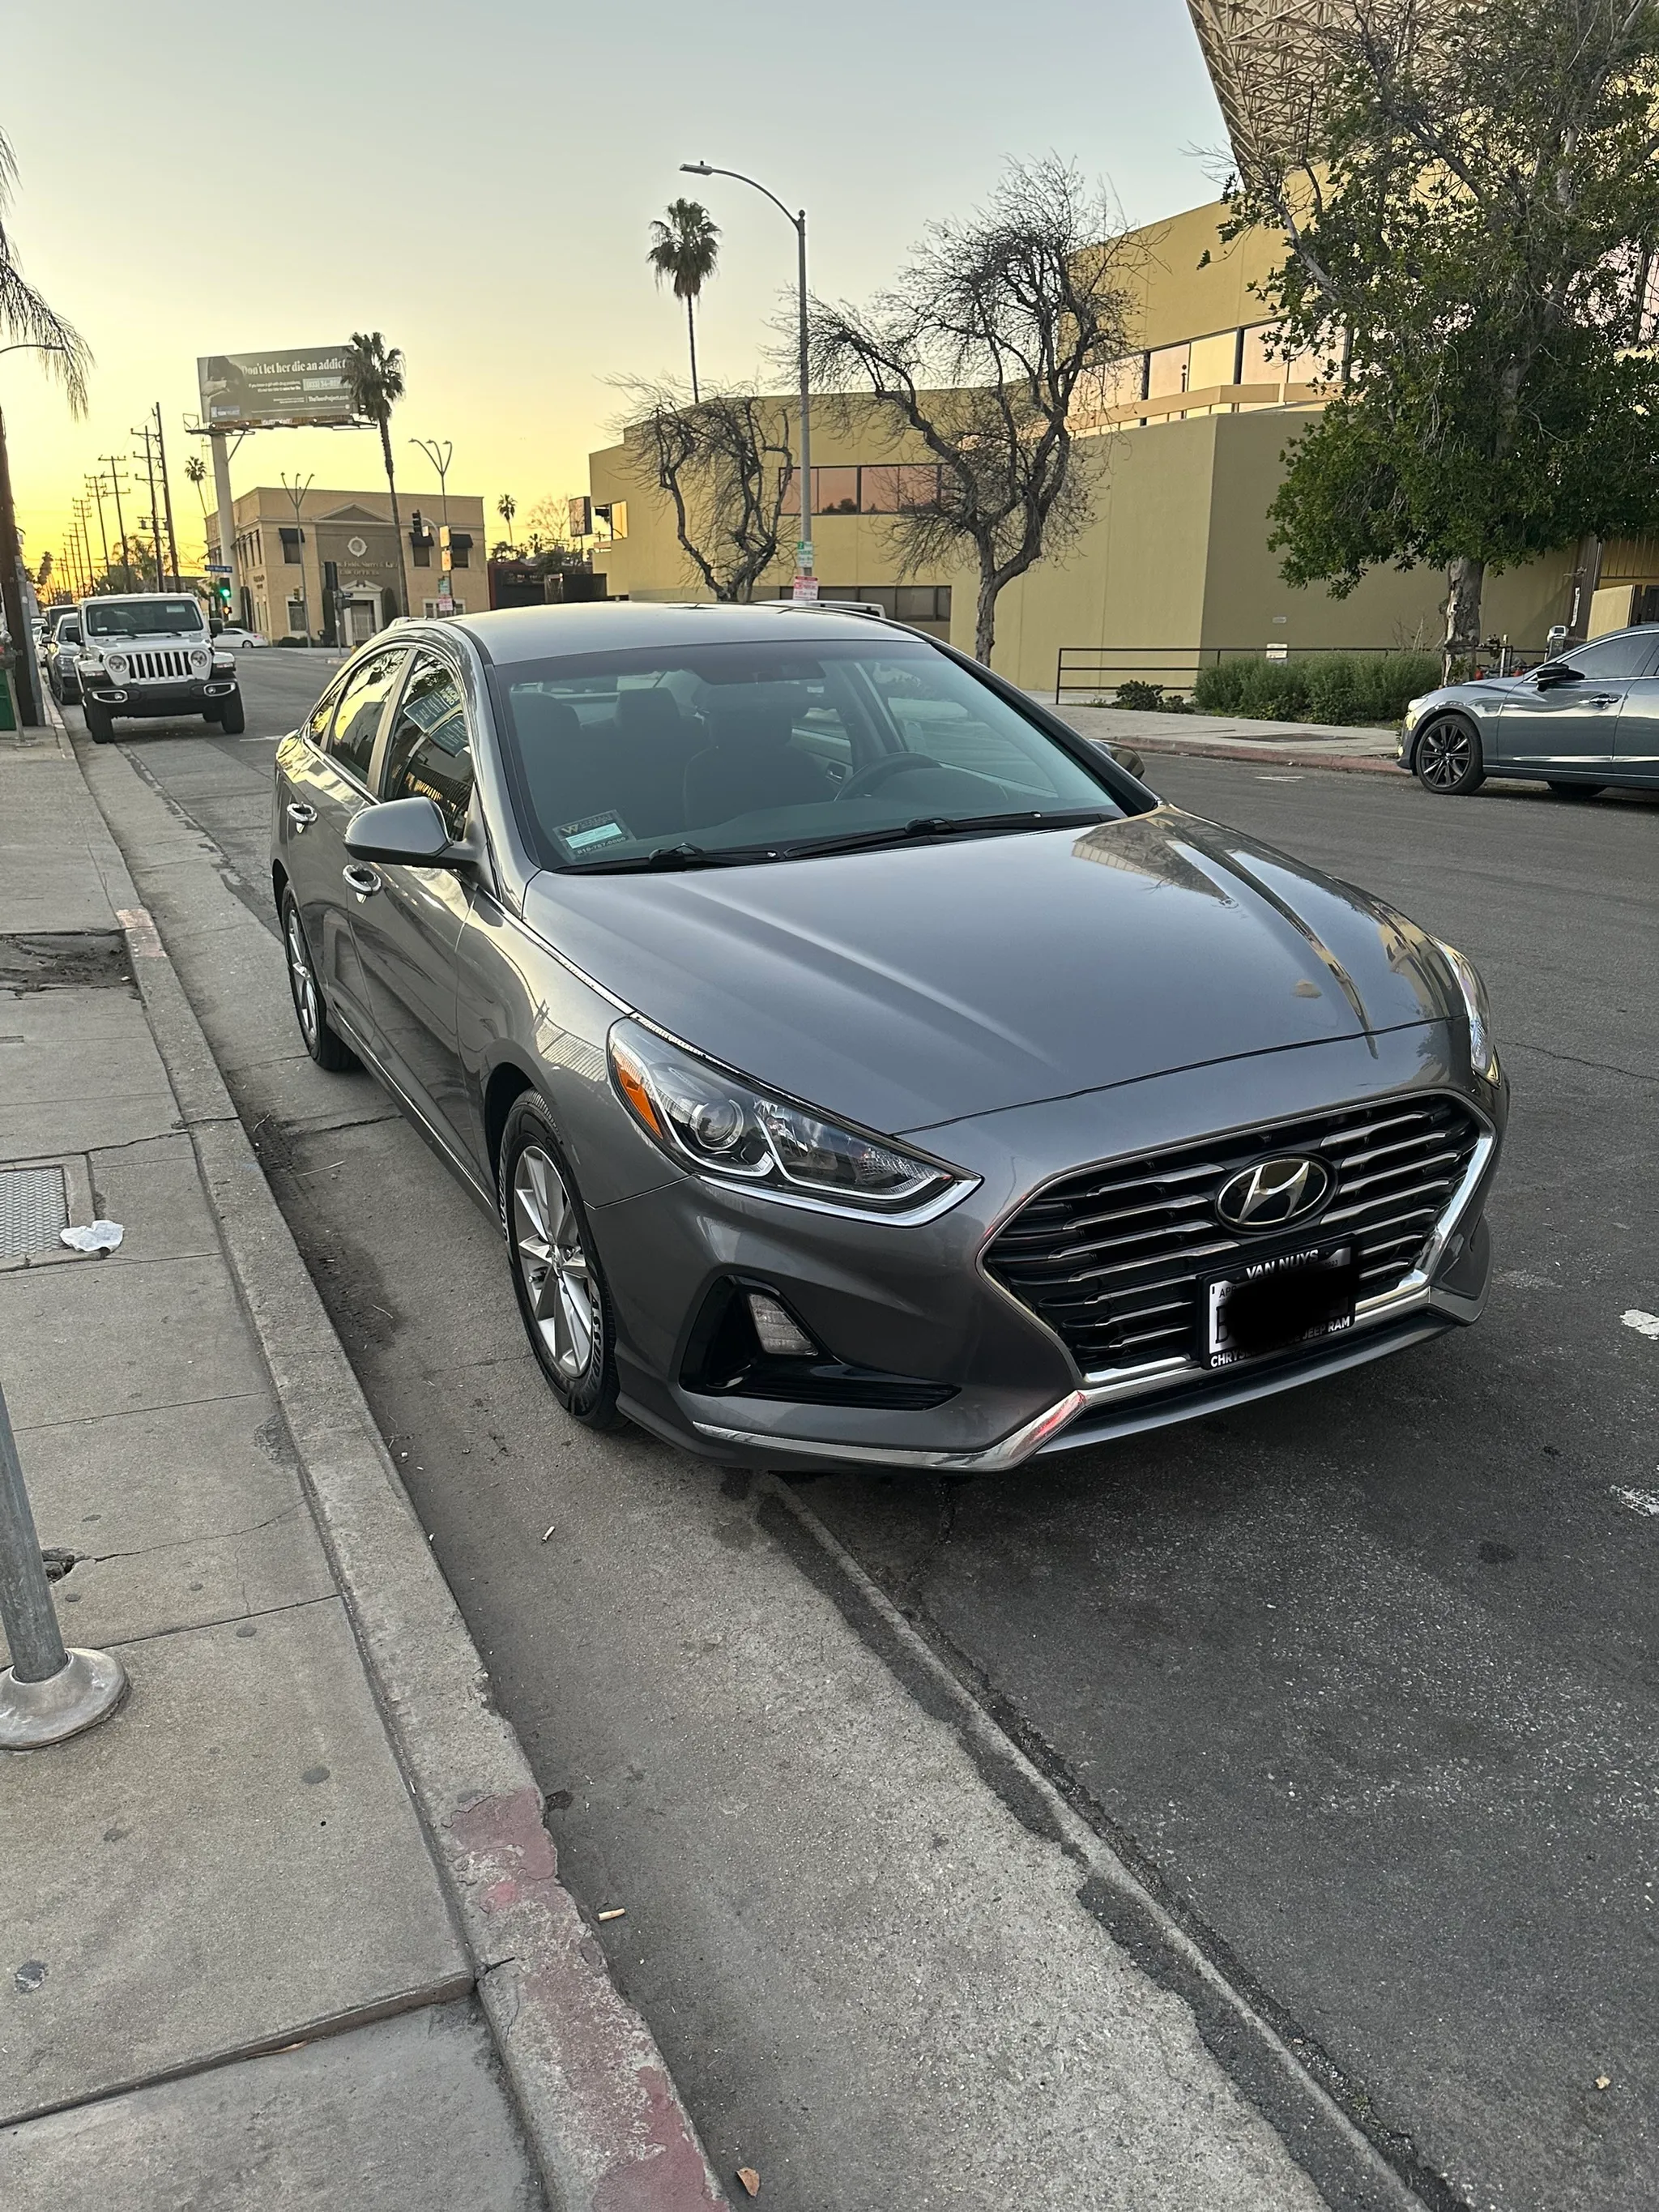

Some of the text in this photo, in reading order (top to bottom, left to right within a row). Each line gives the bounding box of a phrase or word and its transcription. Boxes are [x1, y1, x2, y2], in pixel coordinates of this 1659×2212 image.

[242, 357, 346, 374] Don't let her die an addict
[1246, 1249, 1319, 1280] VAN NUYS
[1328, 1316, 1350, 1333] RAM
